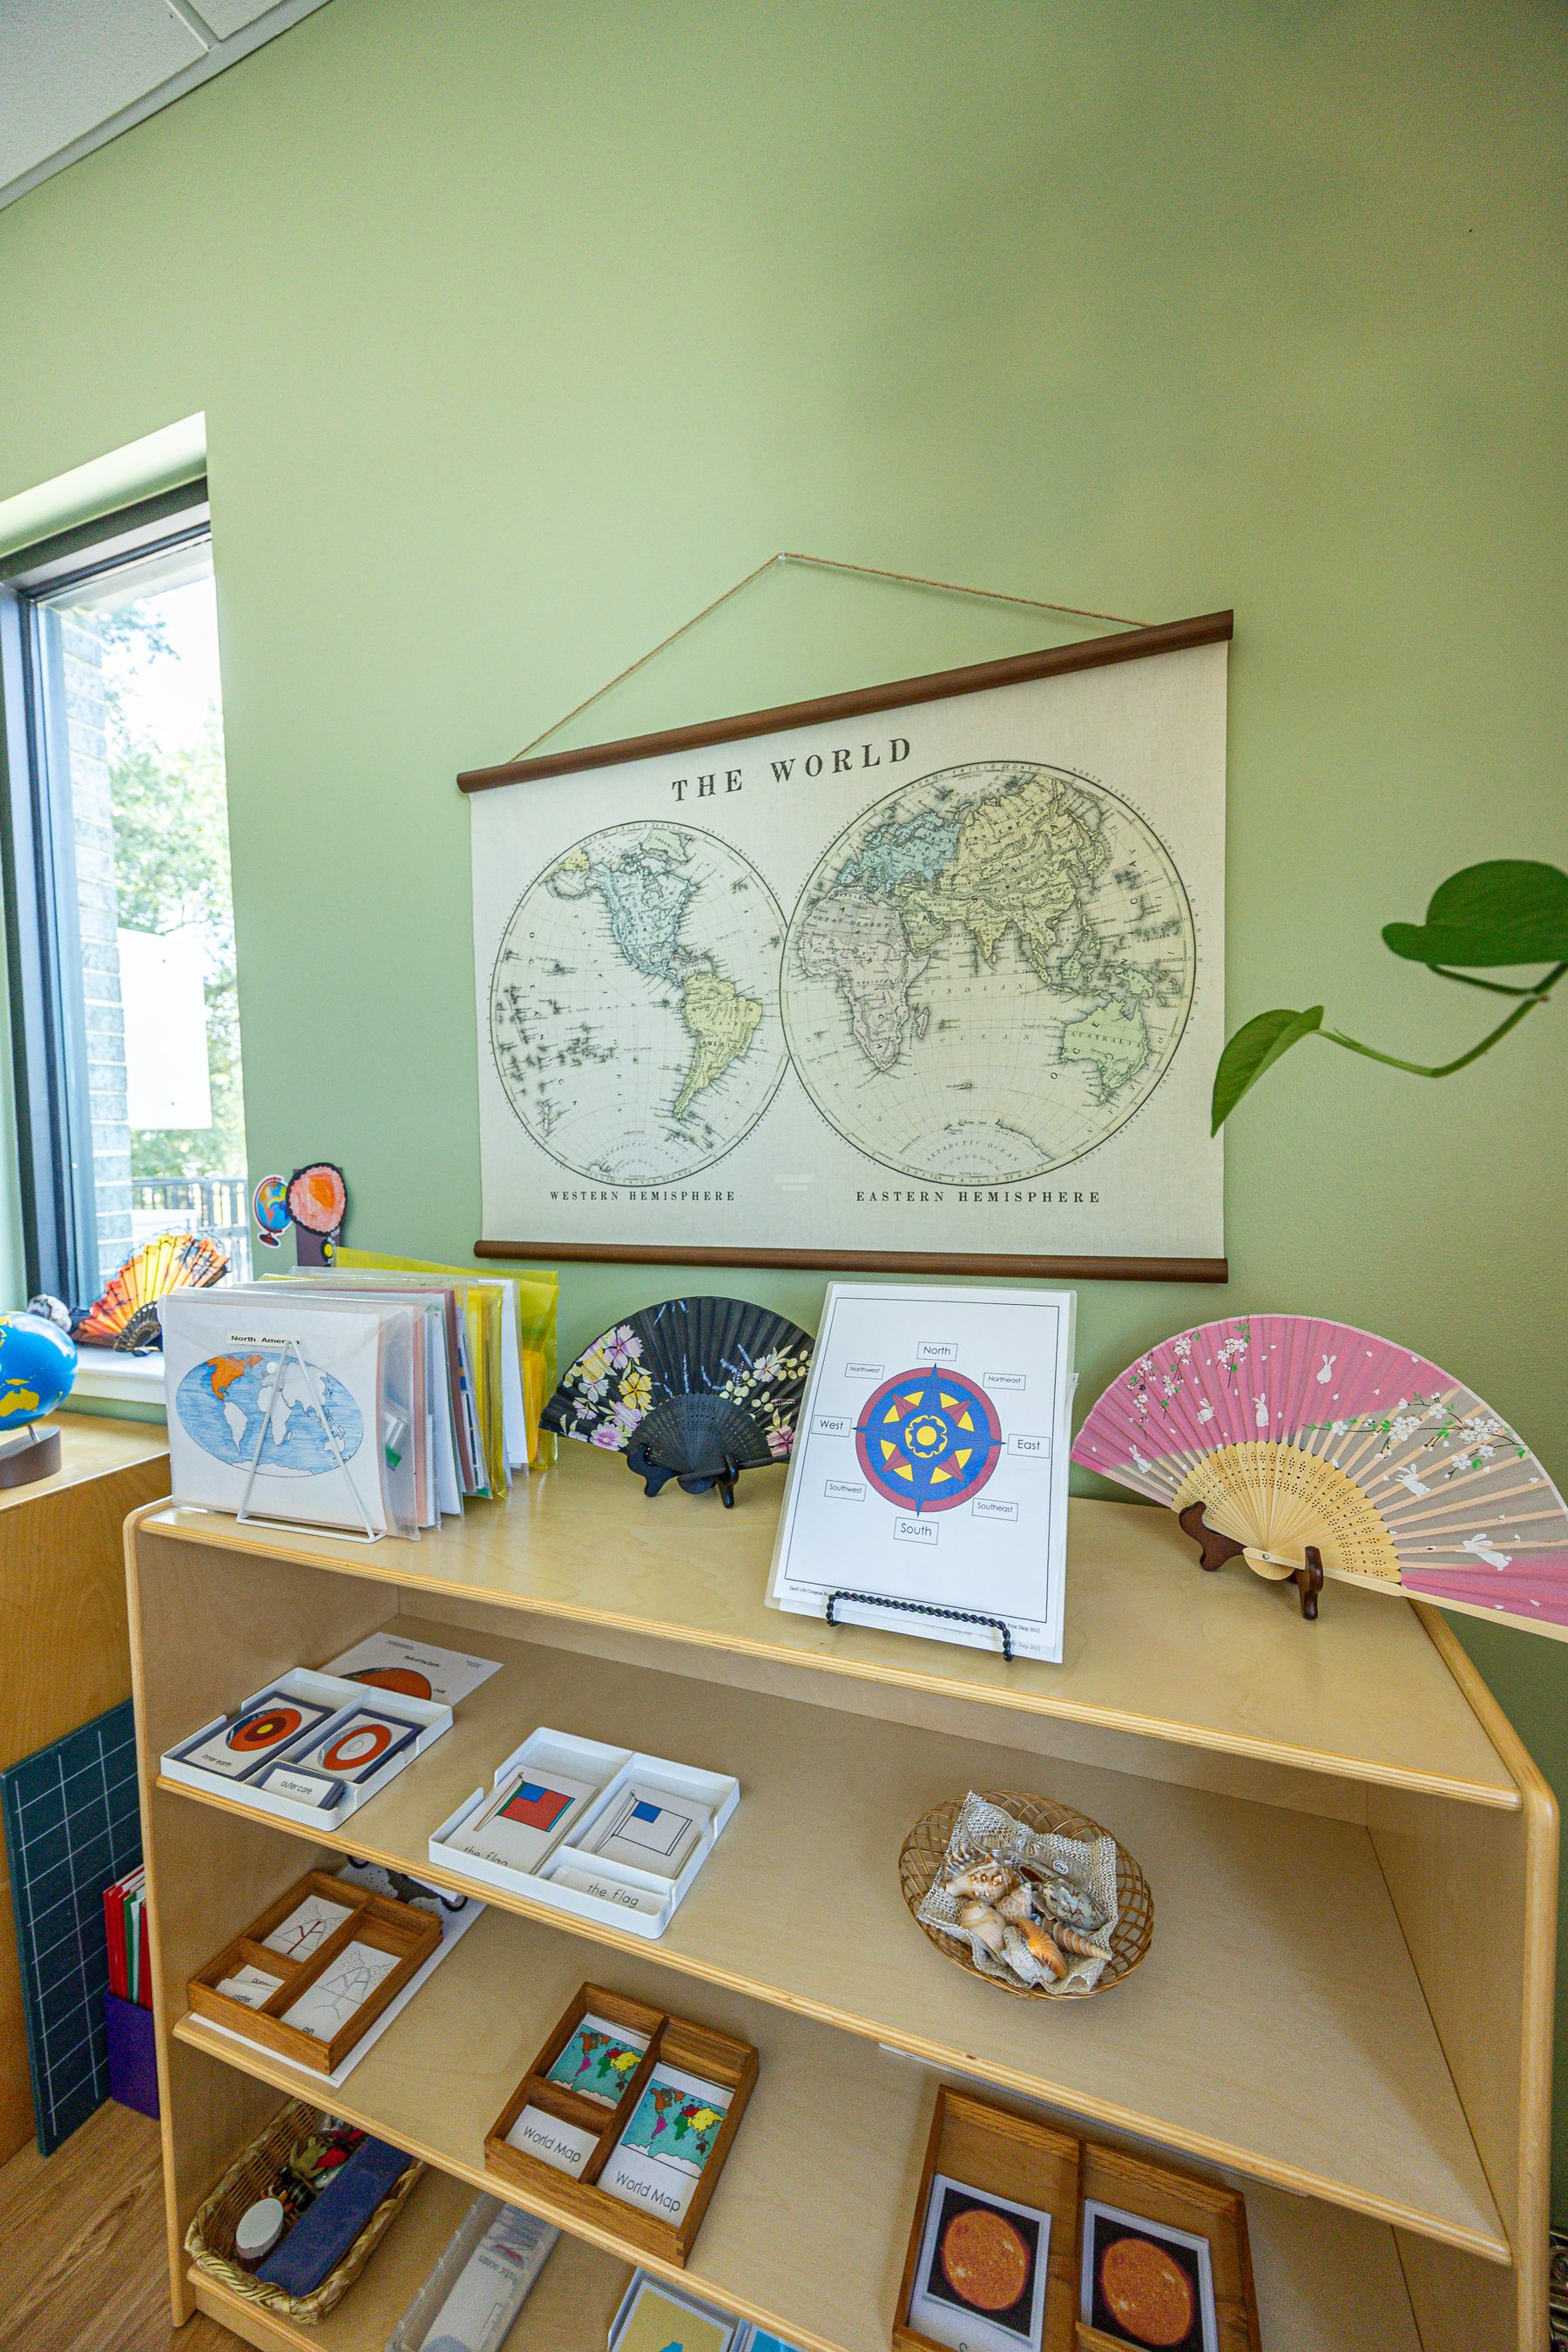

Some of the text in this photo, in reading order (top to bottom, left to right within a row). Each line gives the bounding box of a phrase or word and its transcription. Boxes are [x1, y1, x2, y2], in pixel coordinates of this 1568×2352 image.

[672, 737, 910, 802] THE WORLD
[1072, 767, 1102, 784] NORTH
[1109, 785, 1155, 827] TEMPERATE
[813, 915, 890, 929] GREAT DESERT
[930, 983, 1024, 997] INDIAN
[940, 1033, 1031, 1043] OCEAN
[1071, 1031, 1143, 1048] AUSTRALIA
[701, 1040, 744, 1050] AMERICA
[550, 1191, 736, 1202] WESTERN HEMISPHERE
[856, 1191, 1099, 1203] EASTERN HEMISPHERE
[923, 1345, 951, 1356] North
[849, 1365, 881, 1374] Northwest
[988, 1375, 1022, 1384] Northeast
[819, 1418, 844, 1430] West
[1017, 1439, 1041, 1451] East
[828, 1484, 862, 1495] Southwest
[977, 1502, 1014, 1514] Southeast
[900, 1523, 933, 1538] South
[280, 1780, 313, 1795] outer core
[463, 1845, 481, 1858] the
[587, 1882, 639, 1909] the flag
[301, 2025, 314, 2035] ash
[523, 2125, 582, 2164] World Map
[616, 2169, 681, 2213] World Map
